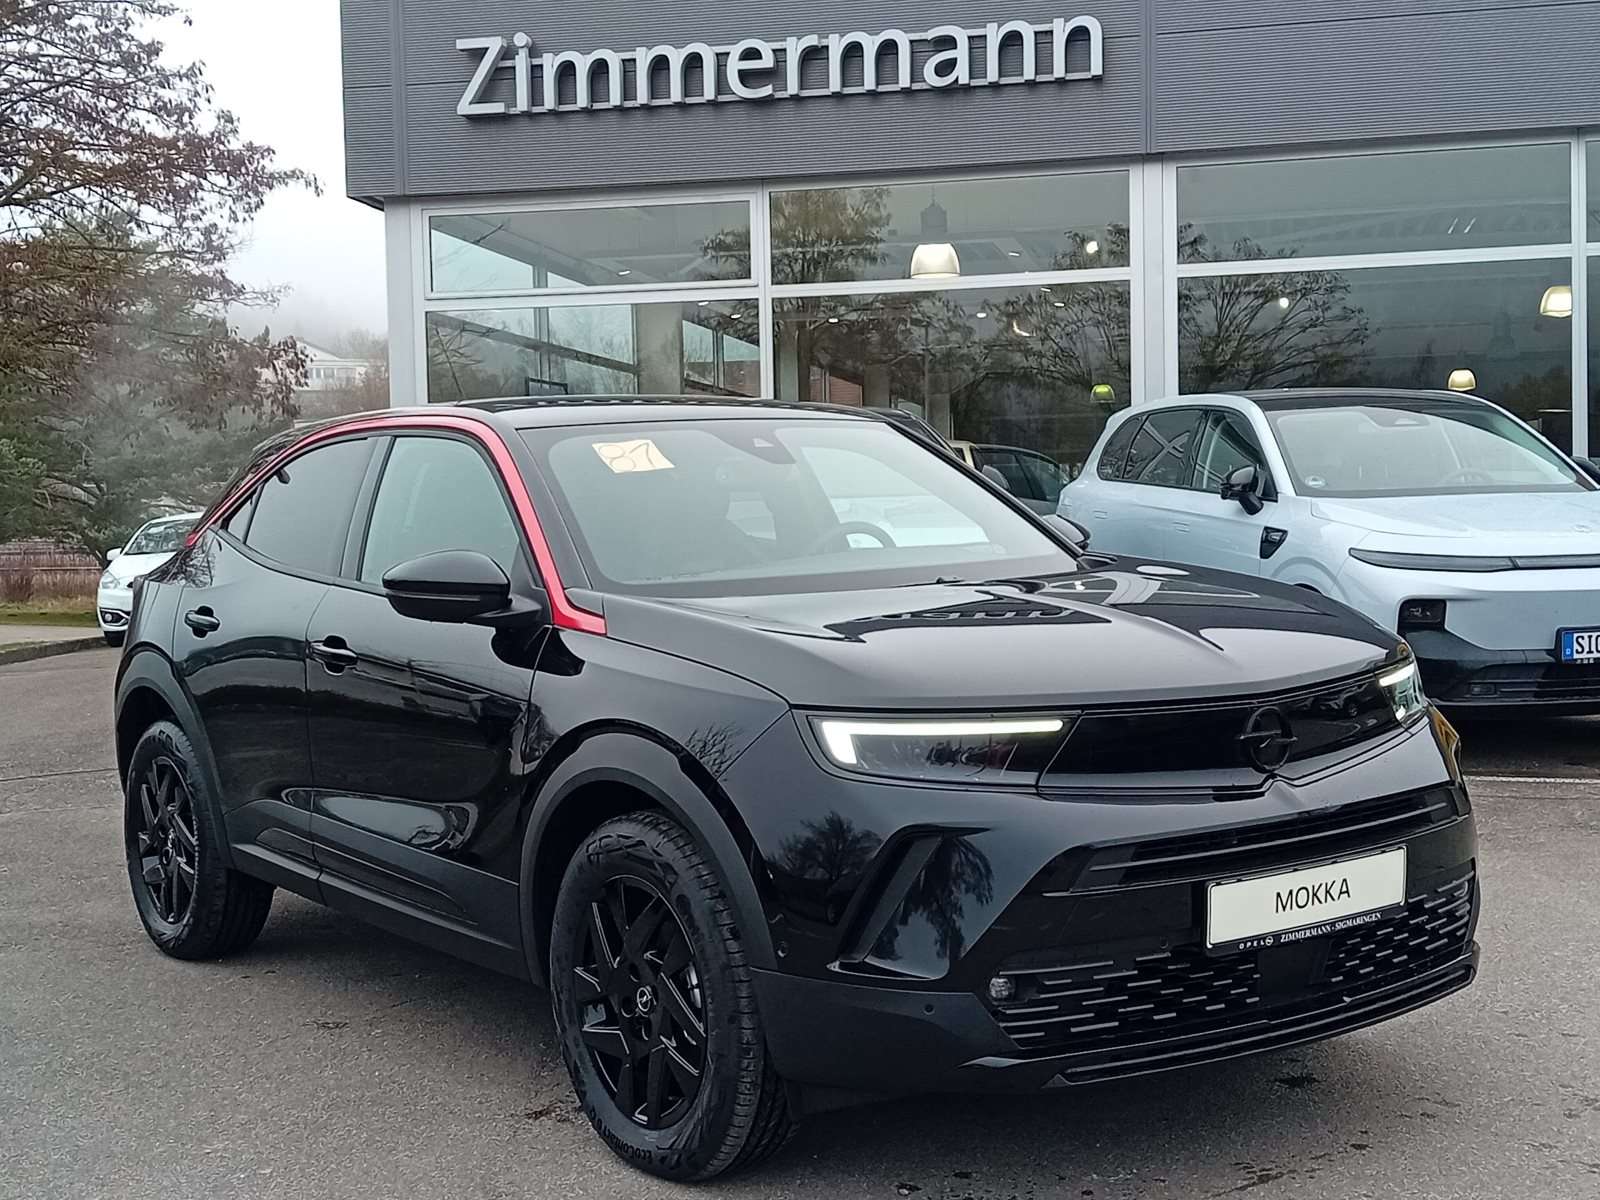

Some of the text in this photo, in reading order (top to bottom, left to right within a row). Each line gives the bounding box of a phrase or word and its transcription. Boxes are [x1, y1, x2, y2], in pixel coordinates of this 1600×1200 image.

[455, 14, 1104, 118] Zimmermann
[1275, 877, 1351, 914] MOKKA
[1239, 940, 1265, 950] OPEL
[1280, 924, 1332, 943] ZIMMERMANN
